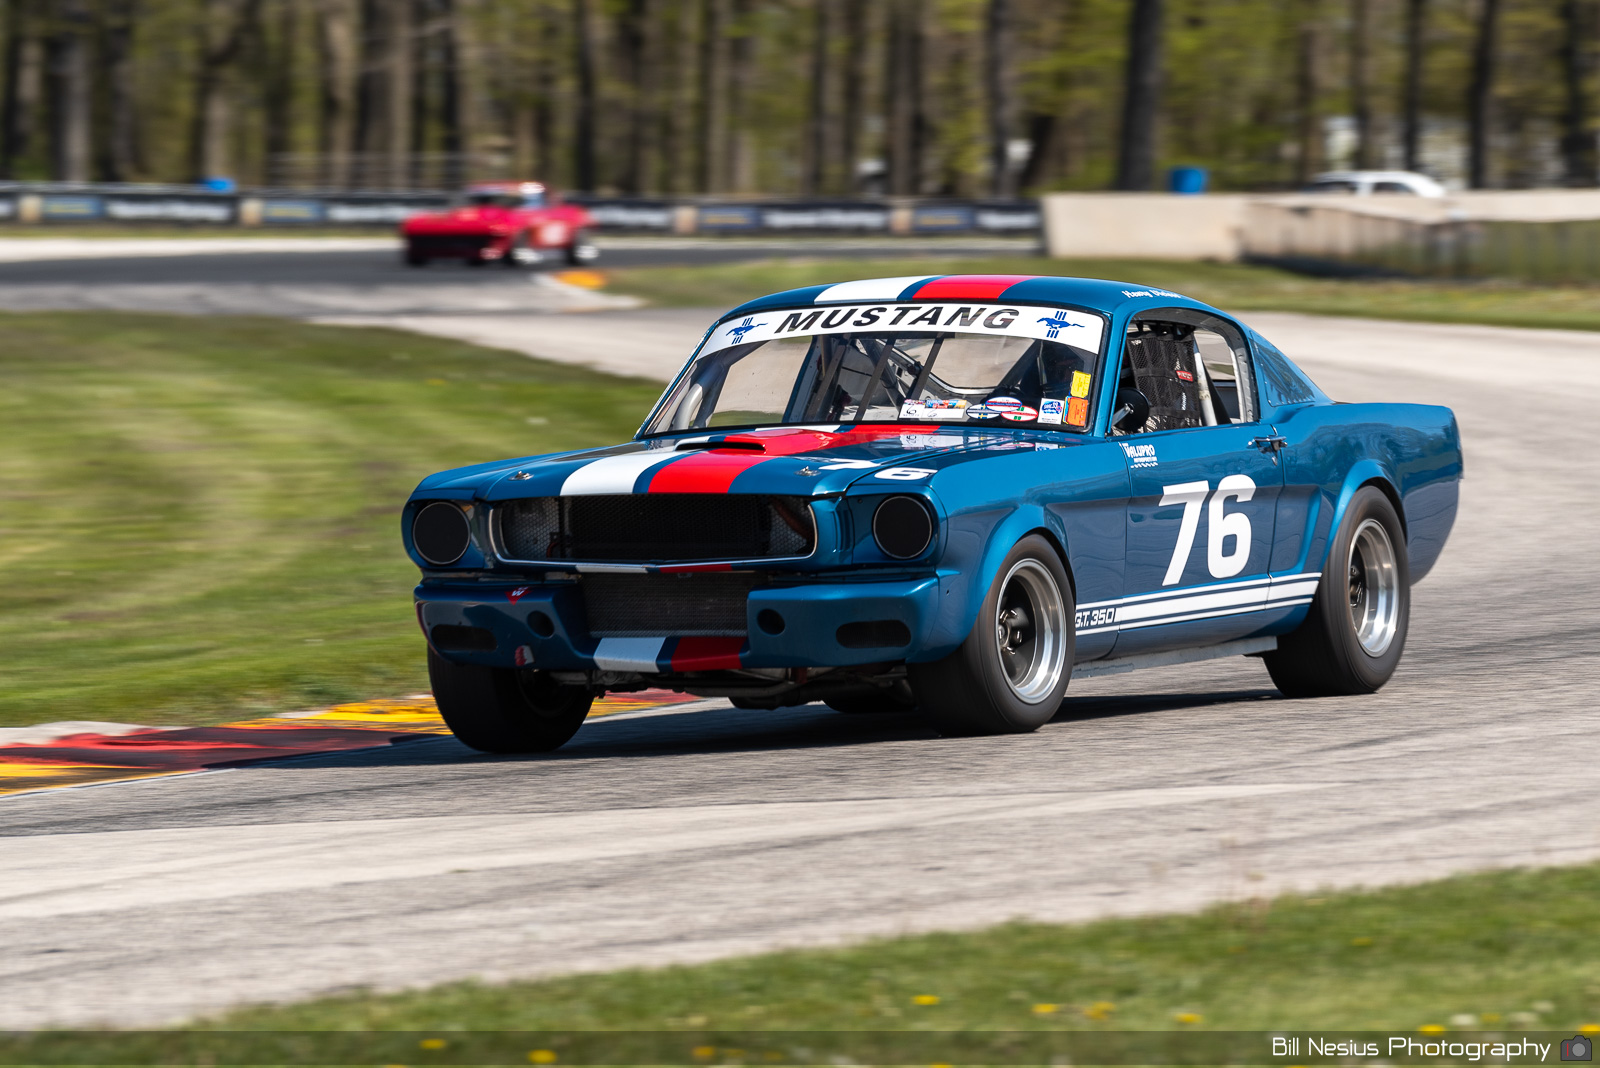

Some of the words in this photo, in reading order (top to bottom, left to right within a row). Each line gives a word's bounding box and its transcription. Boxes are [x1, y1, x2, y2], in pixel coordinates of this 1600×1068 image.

[774, 306, 1019, 334] MUSTANG
[1158, 473, 1257, 587] 76
[1090, 607, 1115, 626] 350
